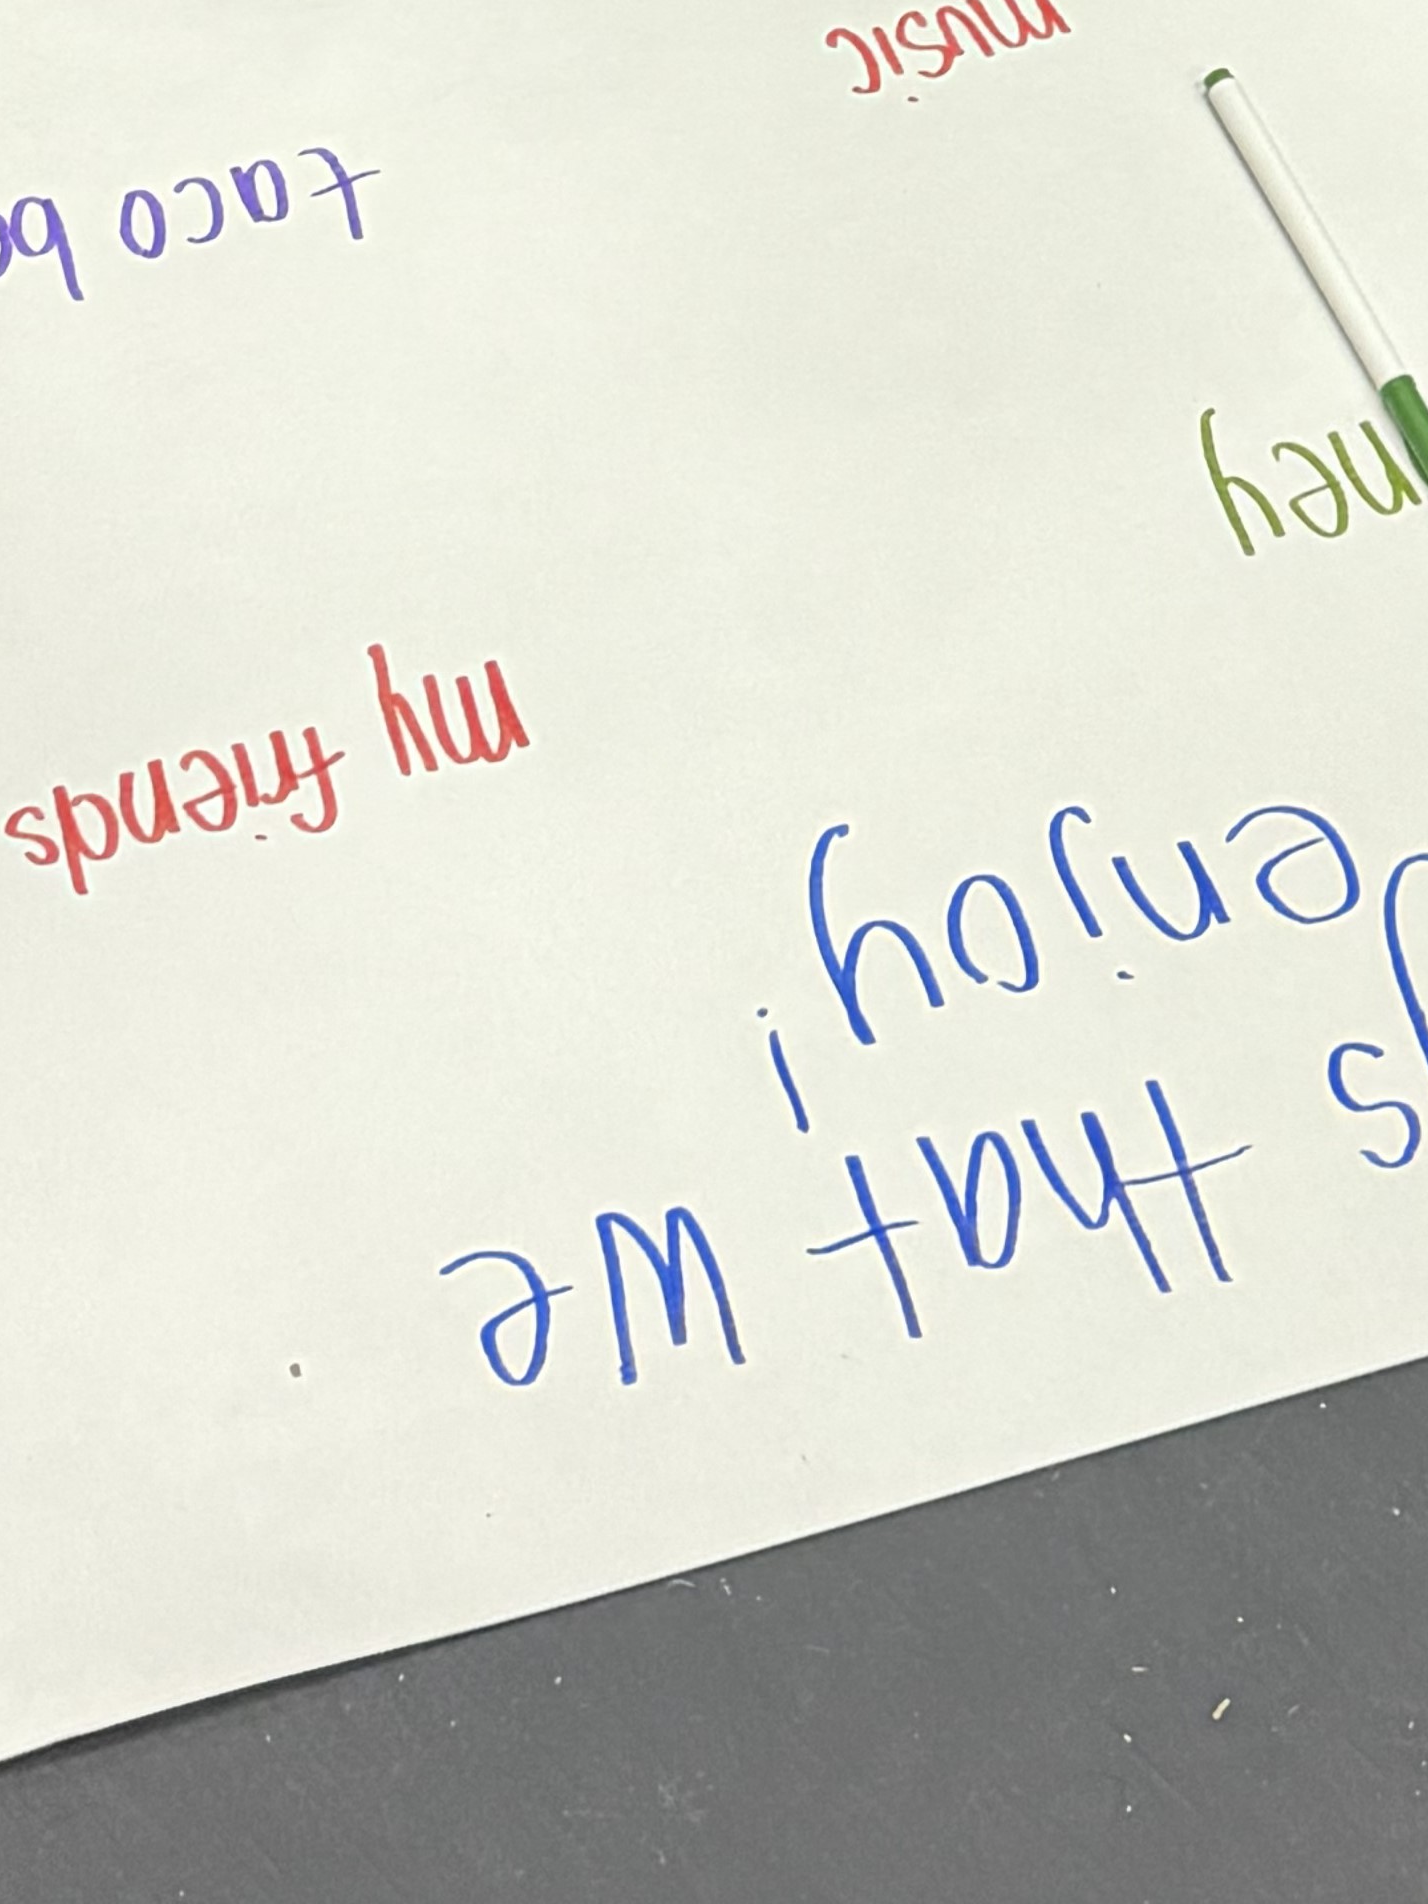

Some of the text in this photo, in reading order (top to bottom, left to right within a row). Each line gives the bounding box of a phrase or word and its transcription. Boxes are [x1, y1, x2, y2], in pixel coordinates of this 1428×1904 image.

[119, 147, 381, 260] taco
[3, 643, 530, 896] my friends
[756, 804, 1361, 1134] enjoy!
[807, 1078, 1254, 1339] that
